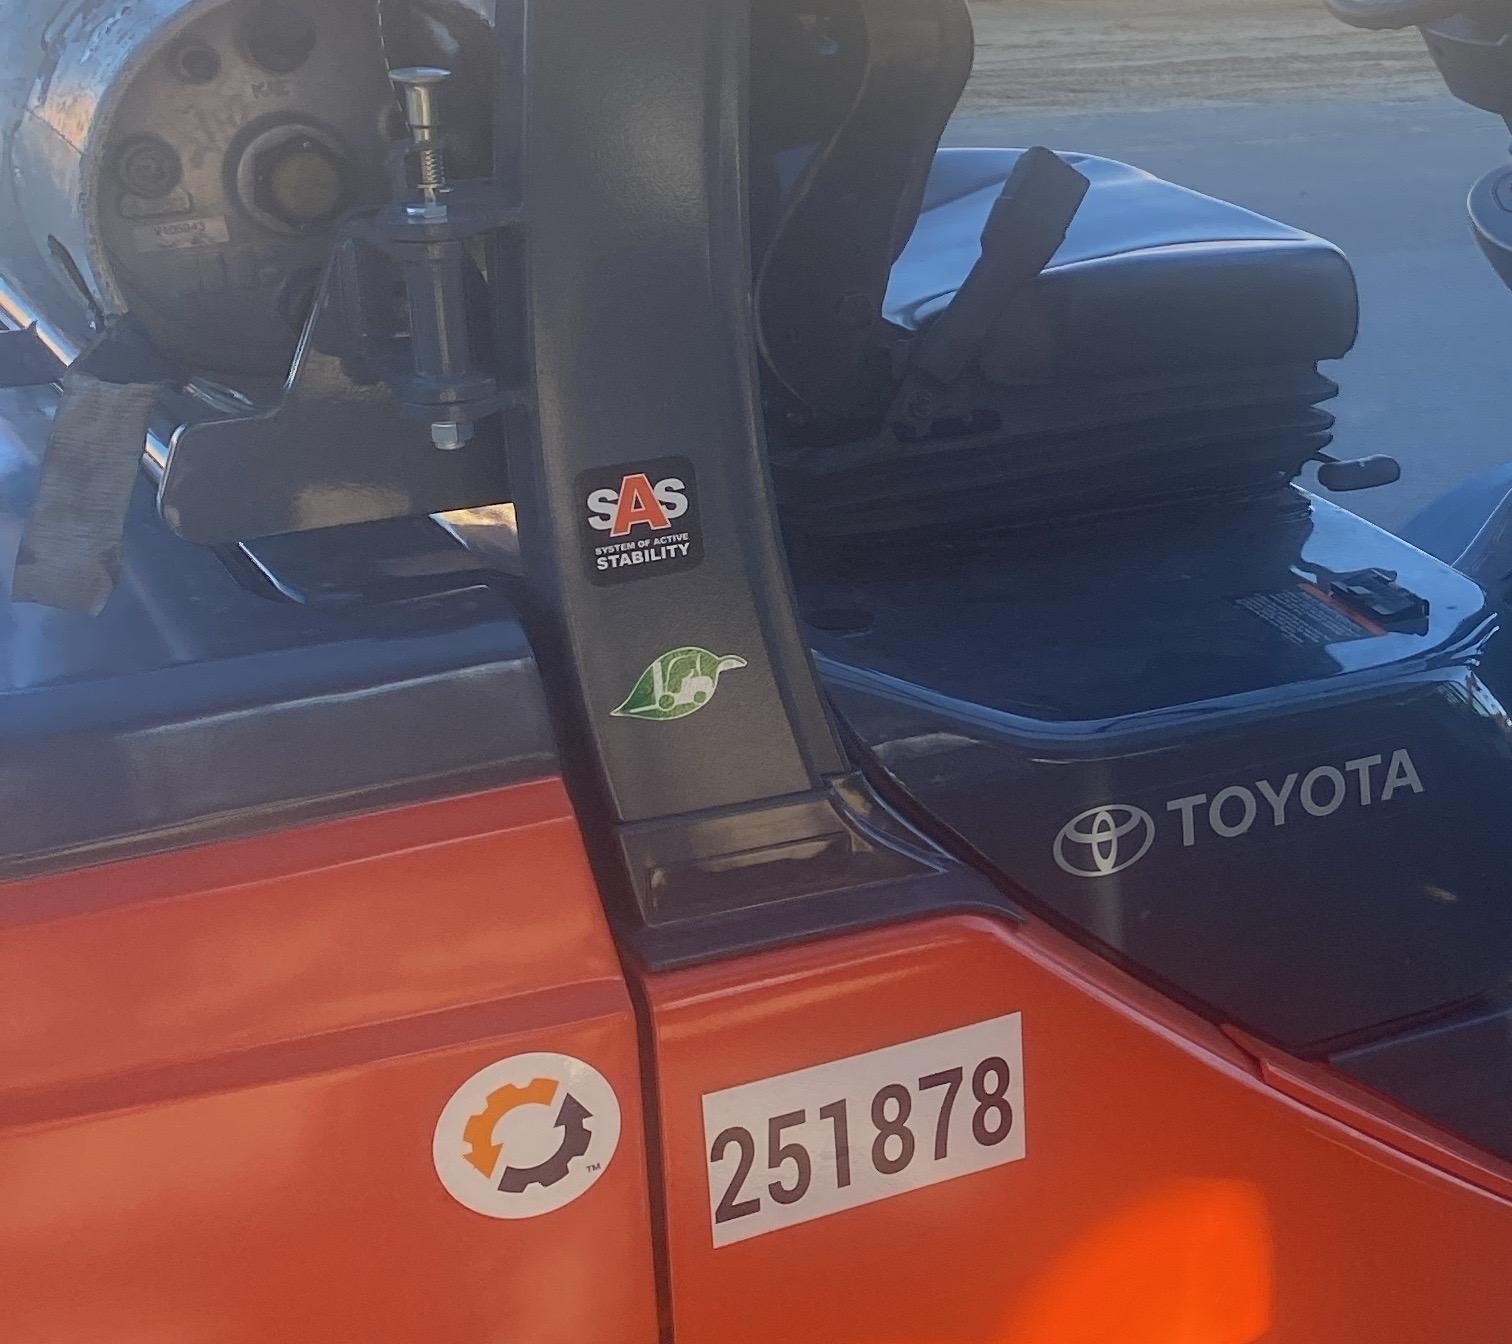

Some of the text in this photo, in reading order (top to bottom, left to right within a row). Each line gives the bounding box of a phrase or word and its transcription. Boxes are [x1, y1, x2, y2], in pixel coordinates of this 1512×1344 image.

[586, 472, 689, 538] SAS
[594, 532, 690, 556] SYSTEM OF ACTIVE
[596, 542, 691, 571] STABILITY
[1166, 747, 1425, 848] TOYOTA
[708, 1055, 1016, 1225] 251878
